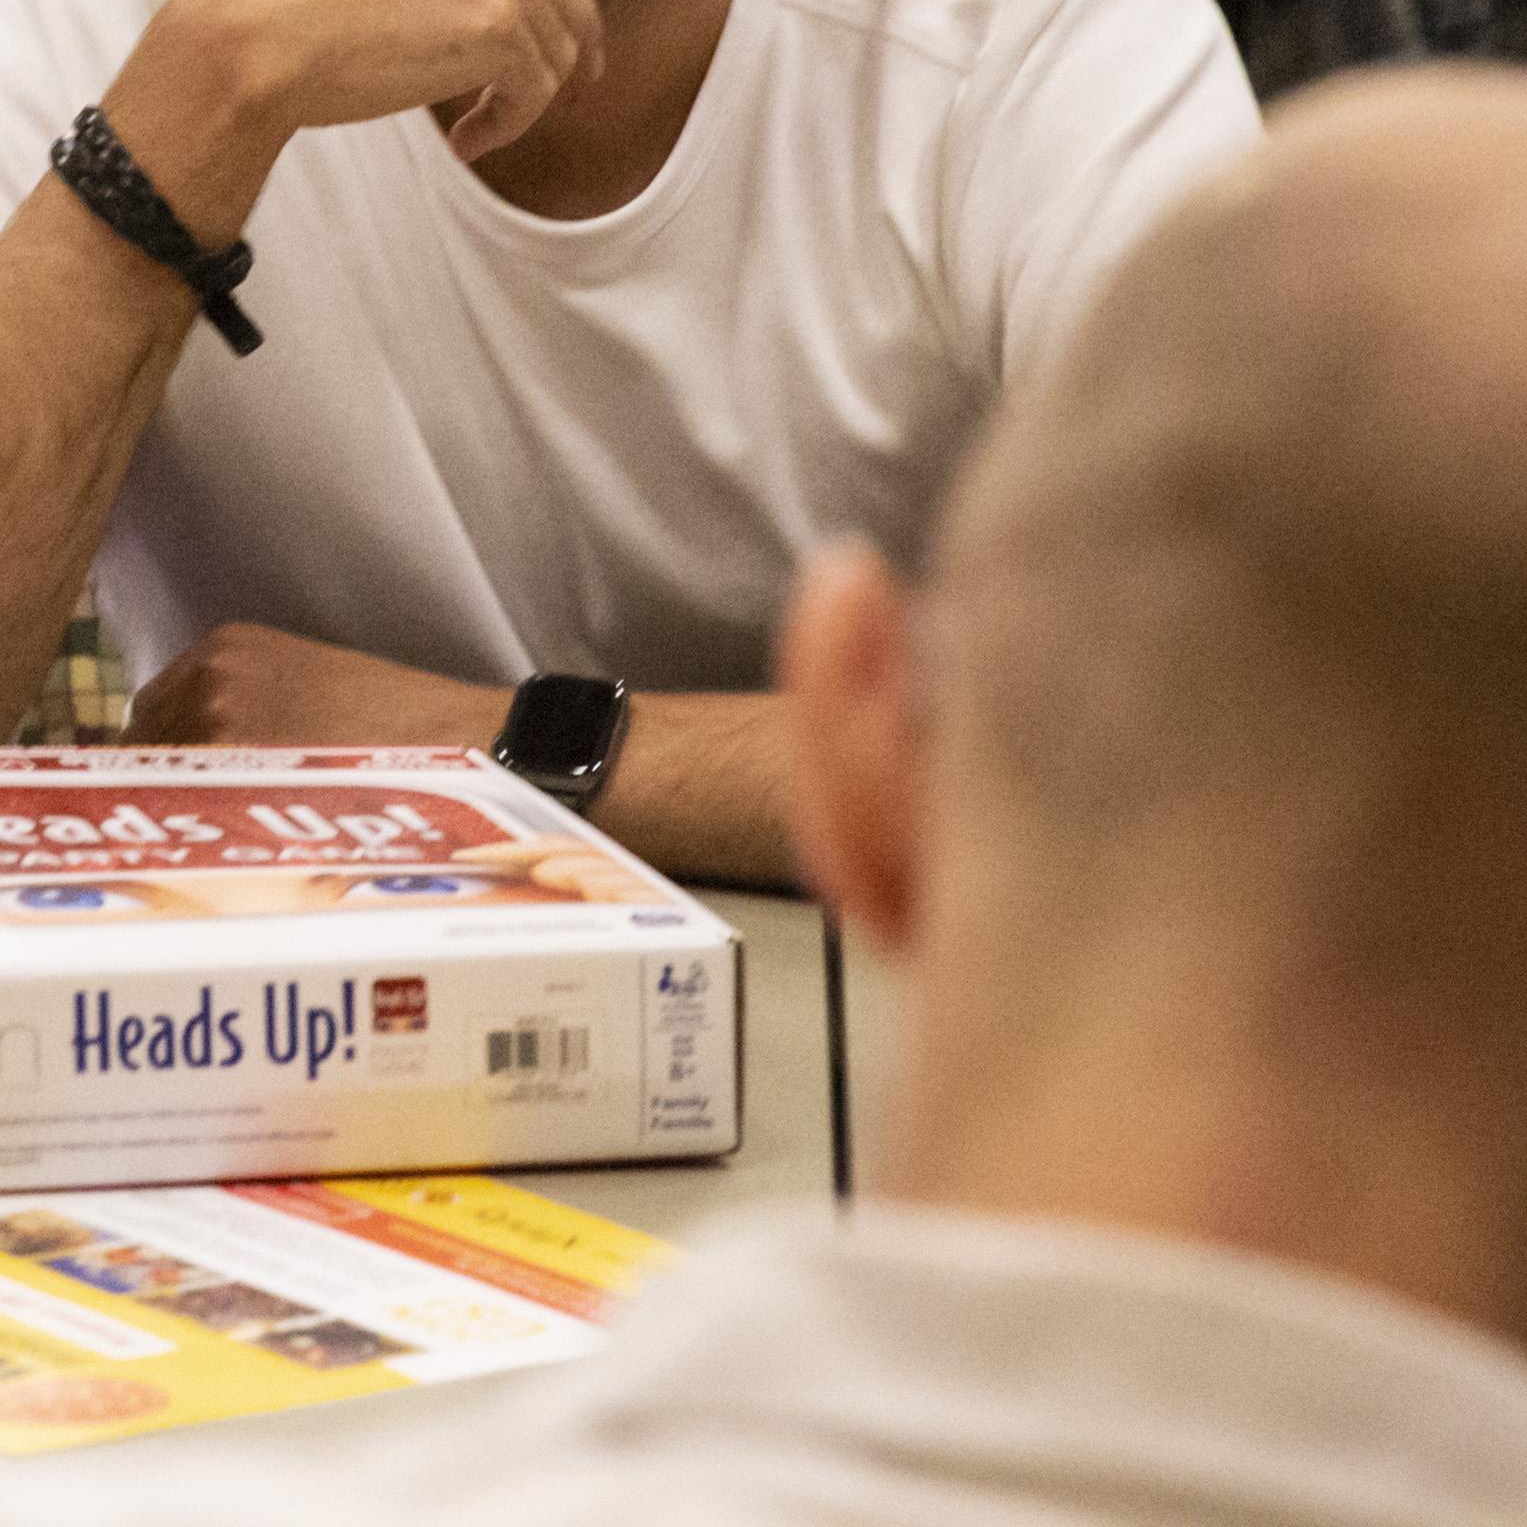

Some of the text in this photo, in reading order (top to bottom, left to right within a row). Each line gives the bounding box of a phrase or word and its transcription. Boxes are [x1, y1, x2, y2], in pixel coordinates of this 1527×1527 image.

[246, 803, 447, 849] Up!
[73, 978, 356, 1080] Heads Up!
